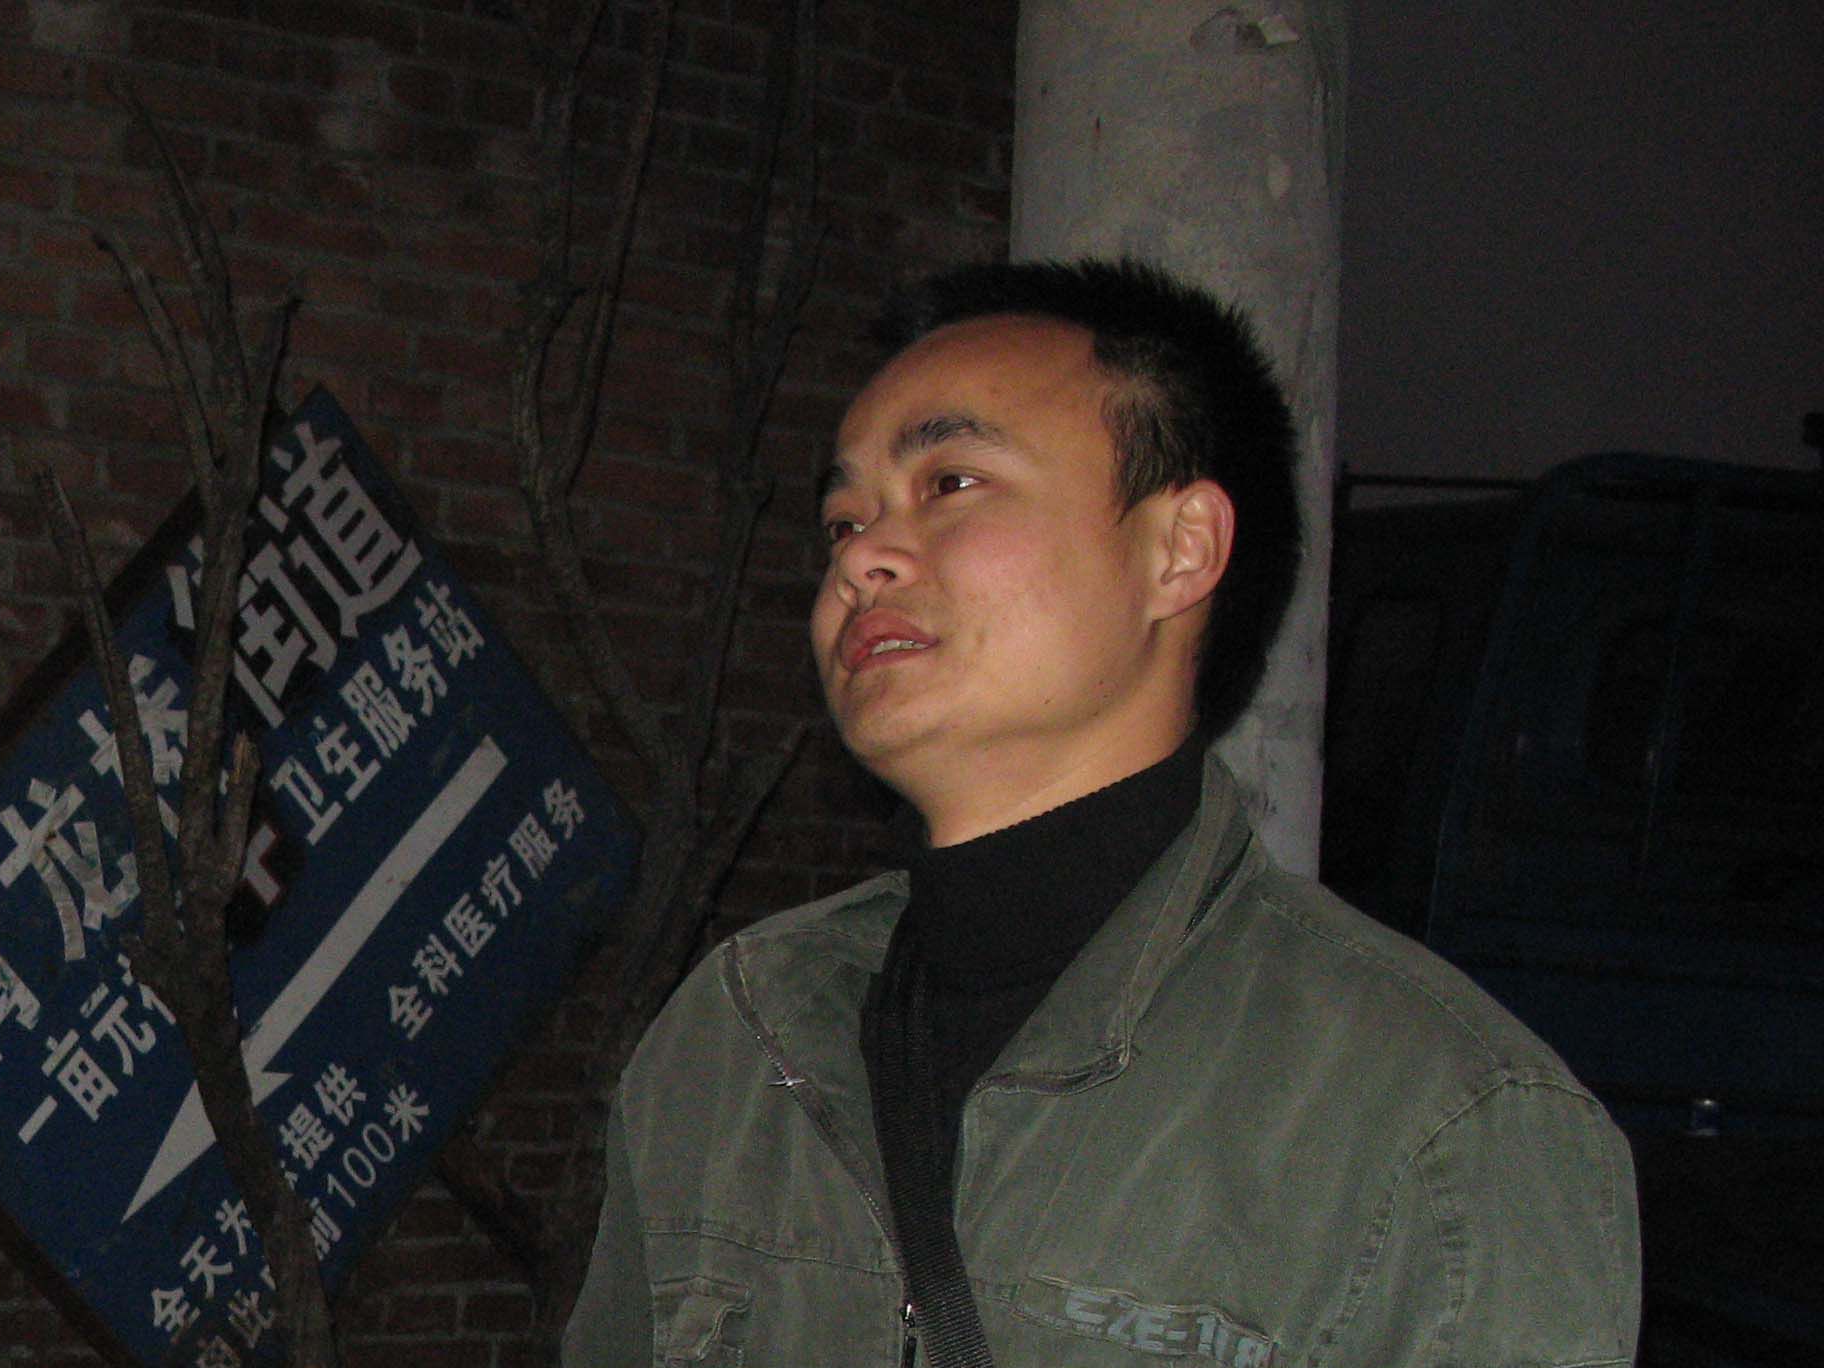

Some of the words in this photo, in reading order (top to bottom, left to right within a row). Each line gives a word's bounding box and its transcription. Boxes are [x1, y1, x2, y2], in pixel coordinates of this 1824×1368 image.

[270, 576, 486, 848] 卫生服务站
[151, 1062, 368, 1338] 全天为提供
[388, 776, 588, 1041] 全科医疗服务
